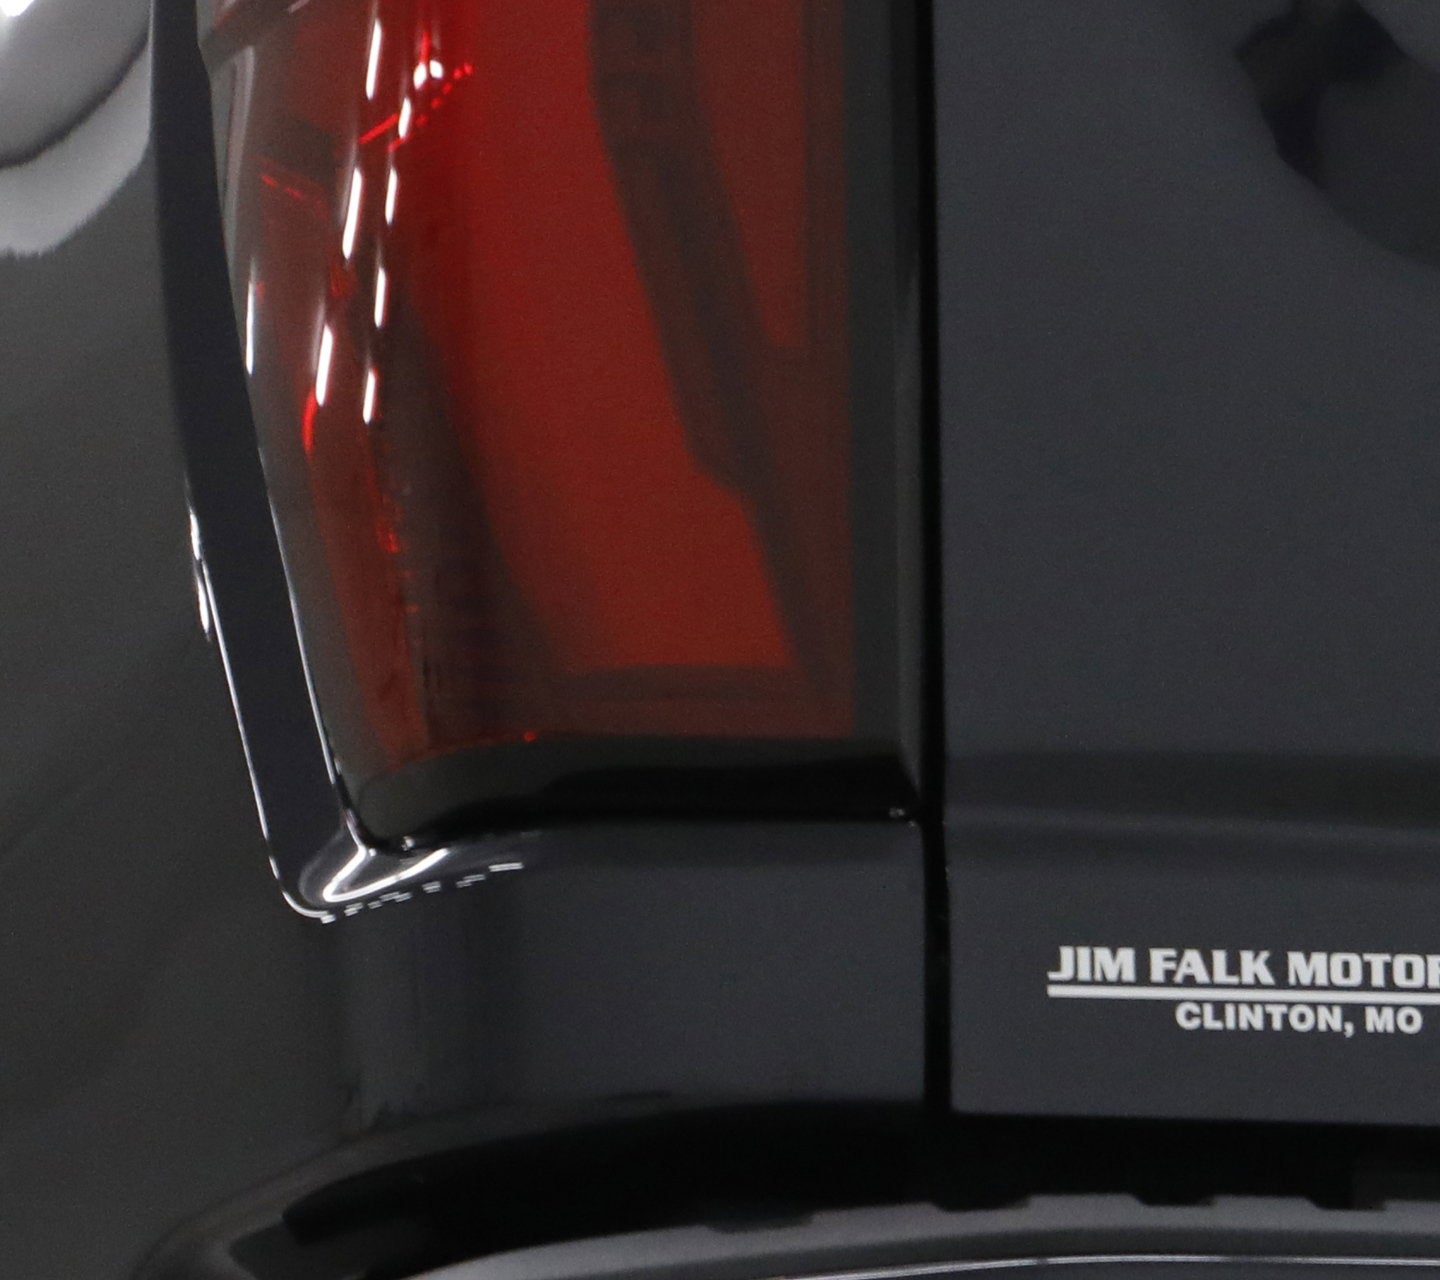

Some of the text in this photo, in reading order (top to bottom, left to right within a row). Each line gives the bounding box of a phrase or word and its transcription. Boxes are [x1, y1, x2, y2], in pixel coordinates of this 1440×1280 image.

[1047, 946, 1136, 983] JIM
[1149, 948, 1275, 986] FALK
[1175, 1002, 1423, 1037] CLINTON, MO
